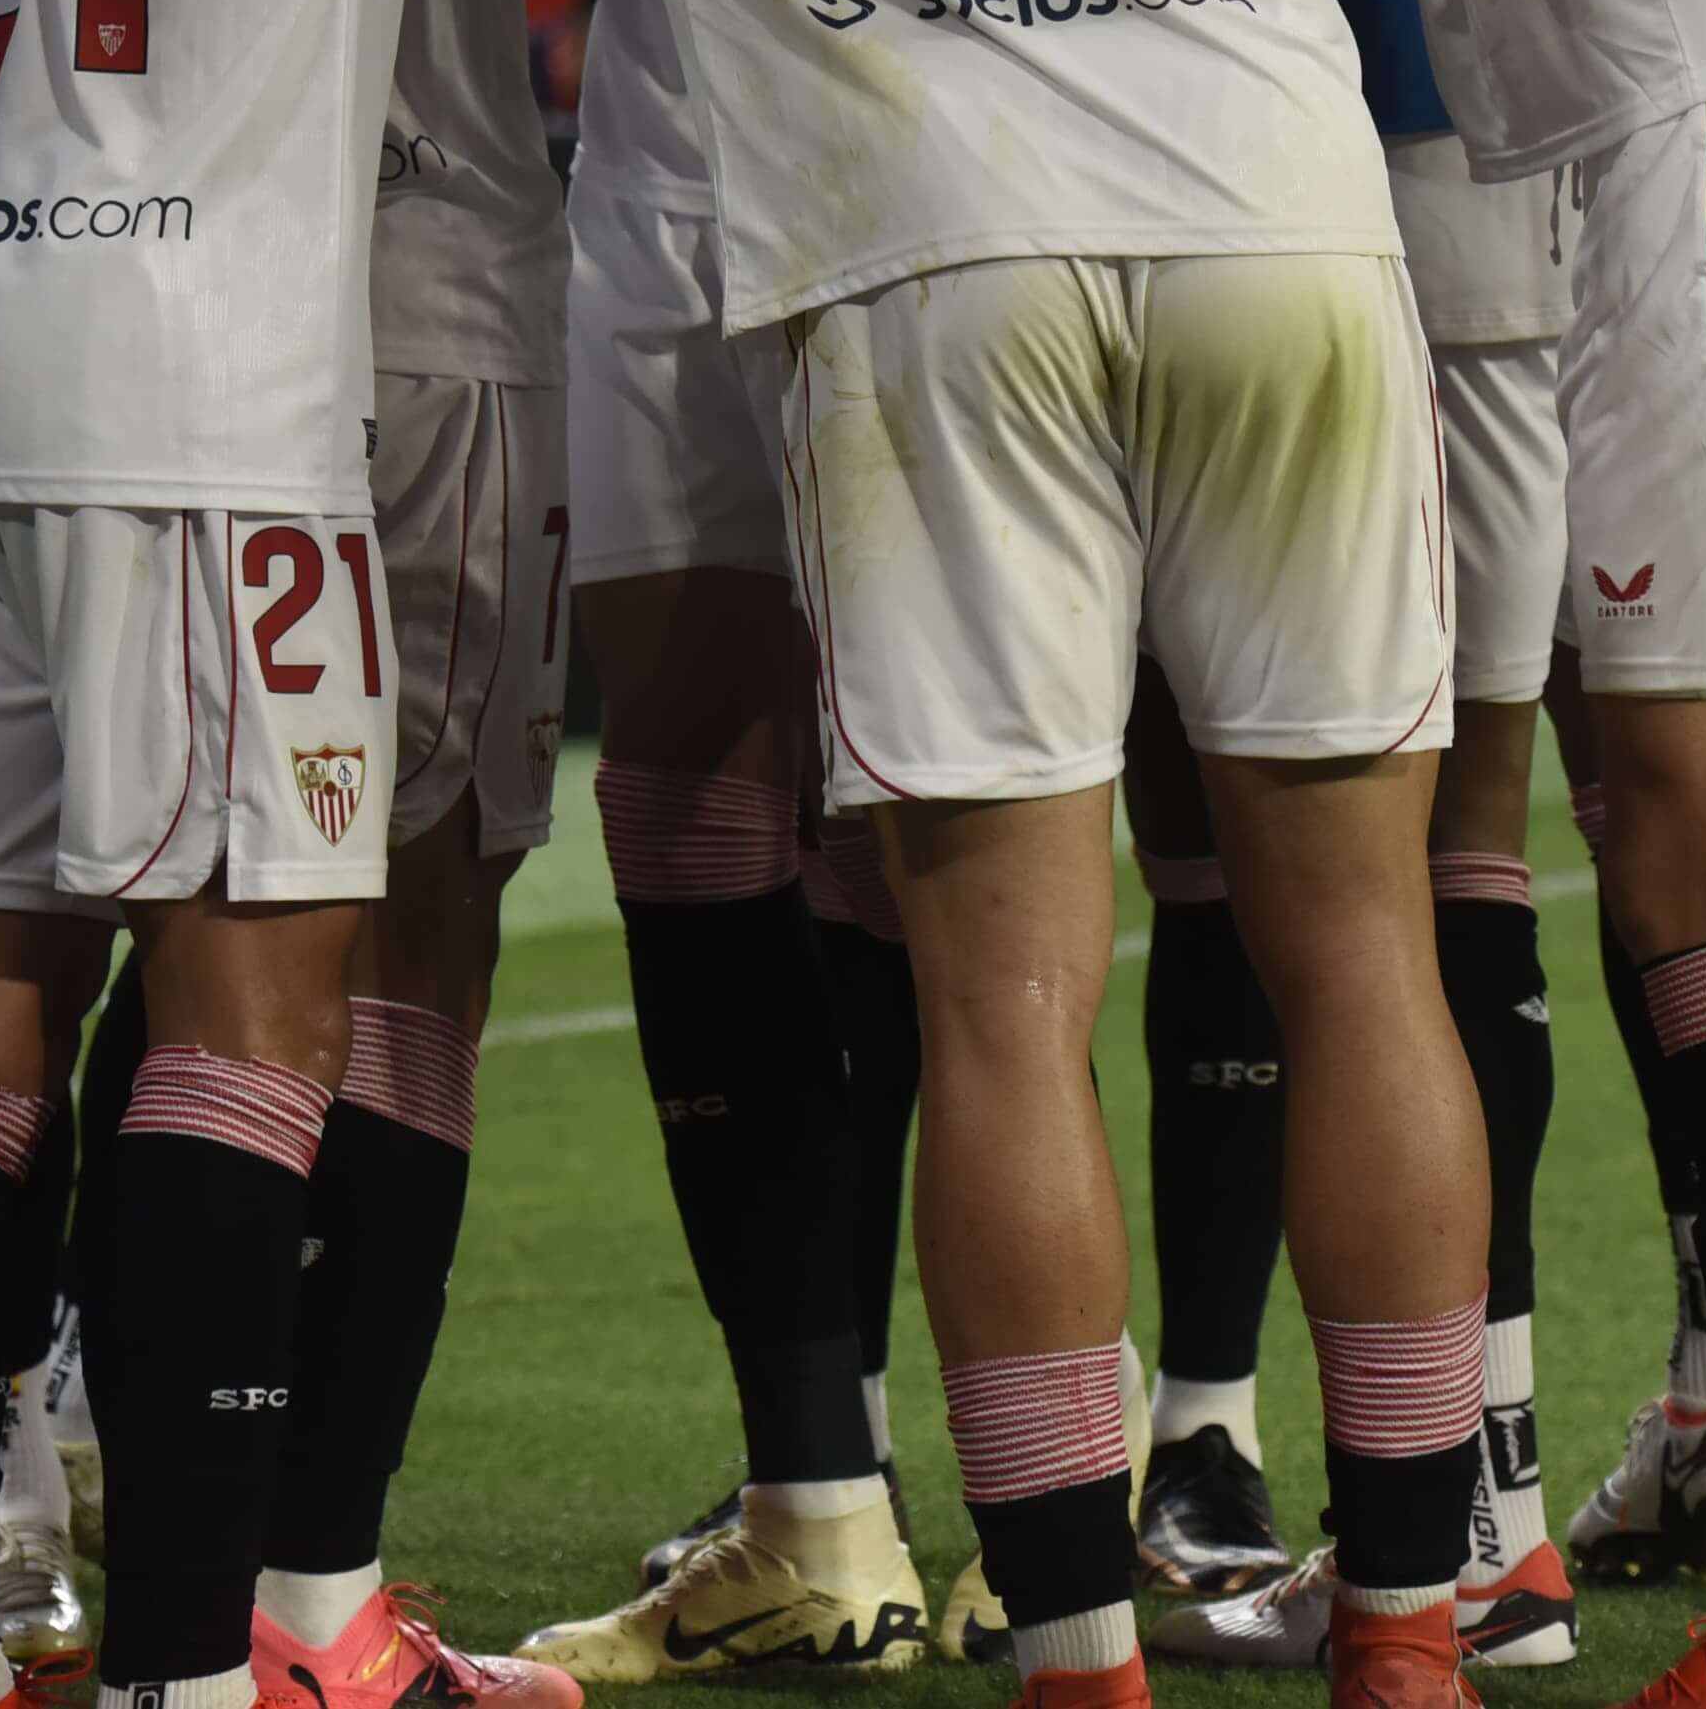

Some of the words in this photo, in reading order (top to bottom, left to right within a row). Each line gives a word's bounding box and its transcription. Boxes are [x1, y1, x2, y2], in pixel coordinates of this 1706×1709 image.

[242, 526, 382, 697] 21
[1597, 604, 1654, 618] CASTORE
[1189, 1059, 1279, 1090] SFC
[209, 1388, 289, 1411] SFC
